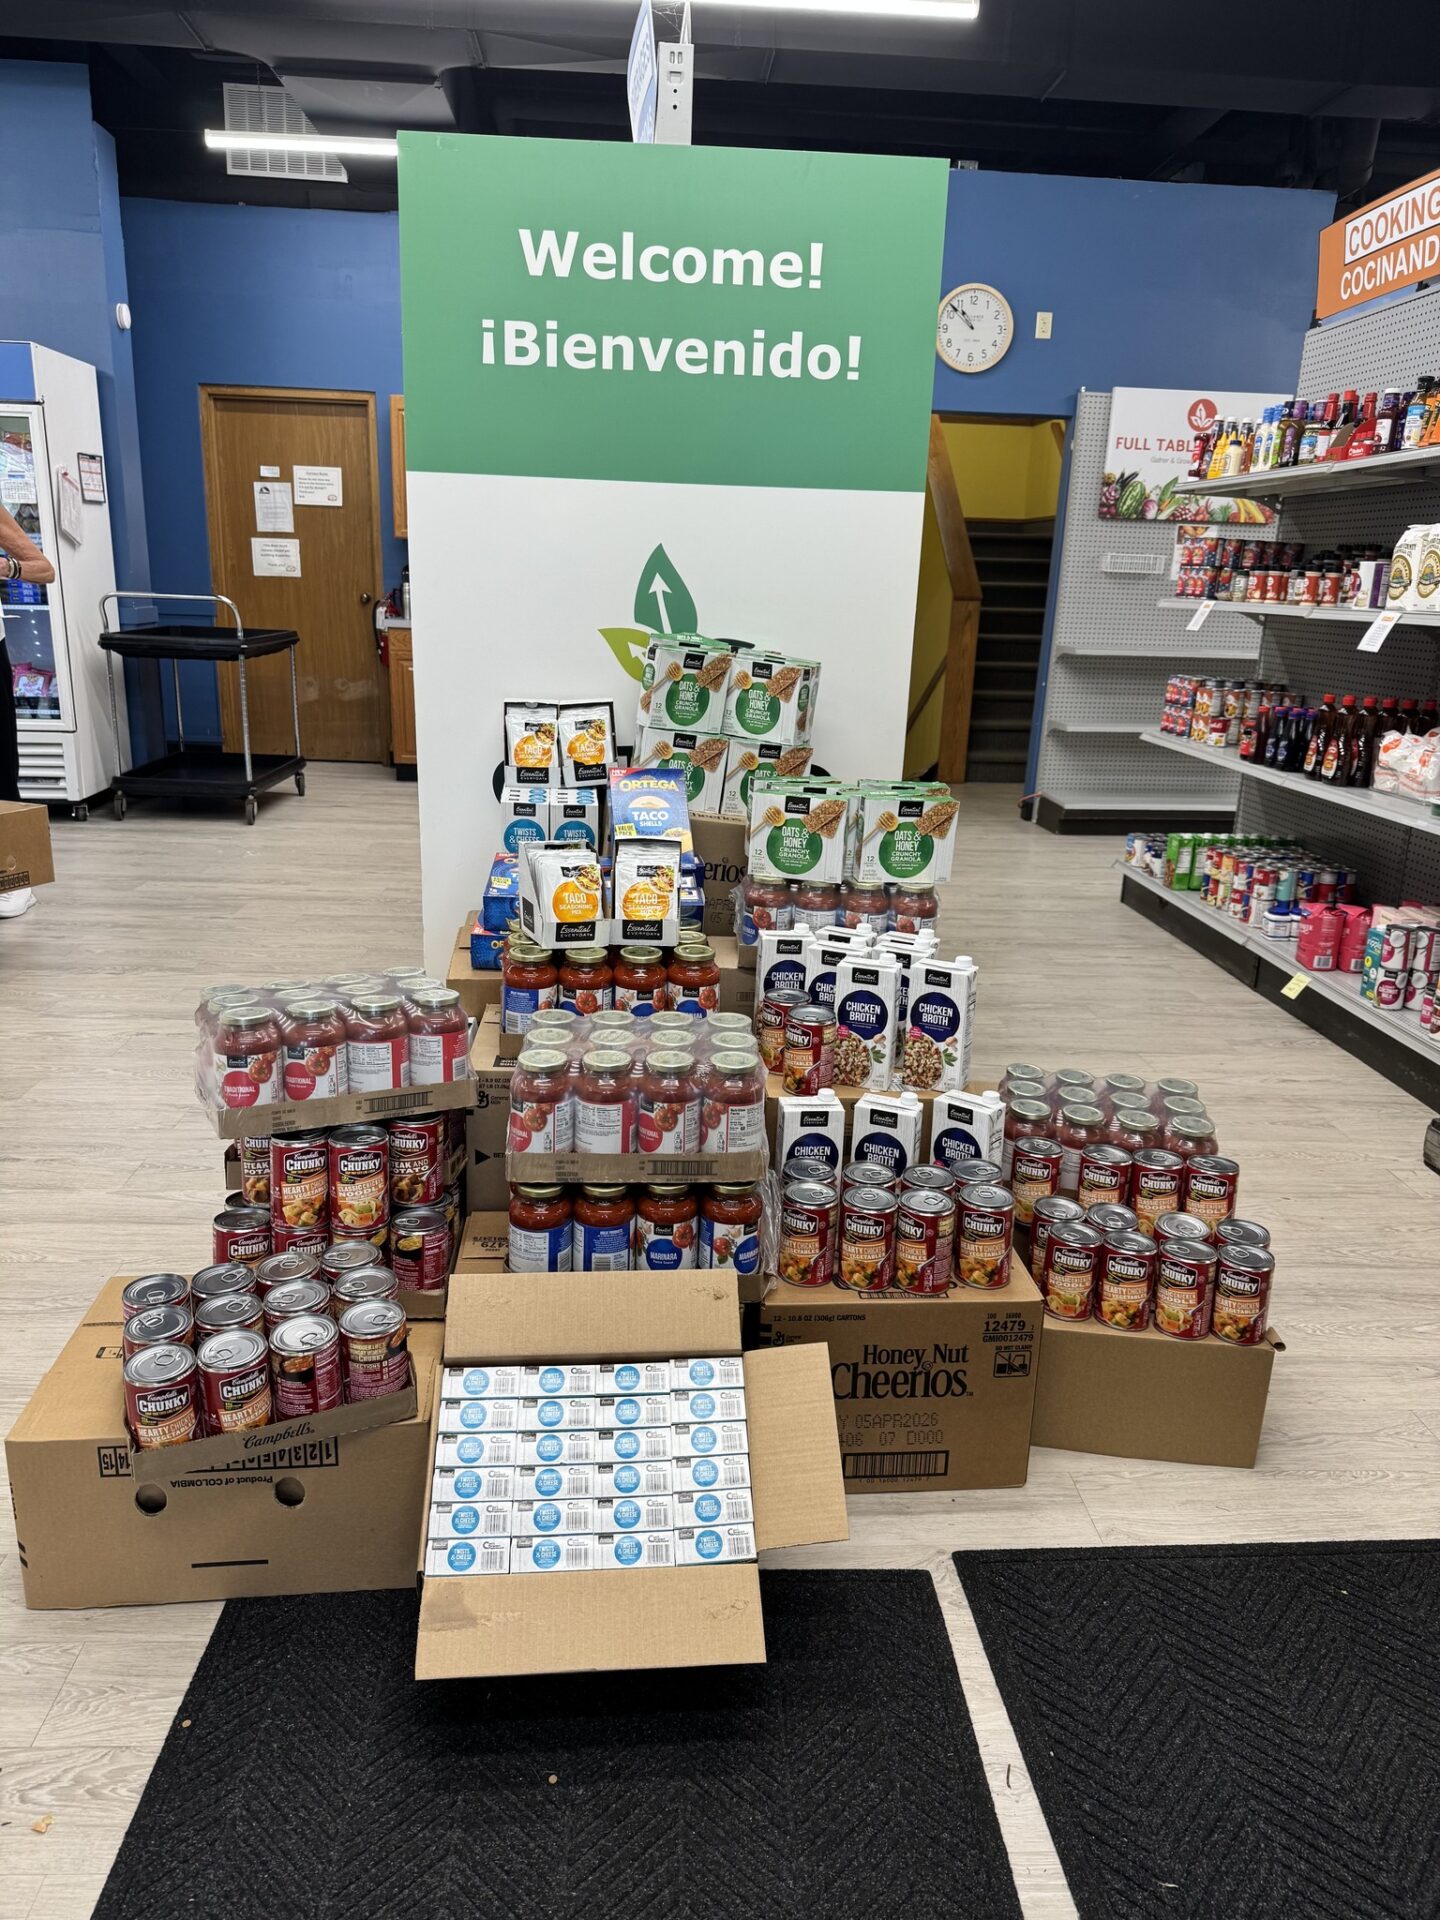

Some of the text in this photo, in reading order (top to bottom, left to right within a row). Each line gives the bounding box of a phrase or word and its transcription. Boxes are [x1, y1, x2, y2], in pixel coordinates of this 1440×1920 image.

[1349, 186, 1440, 257] COOKING
[518, 229, 824, 289] Welcome!
[957, 299, 964, 309] 11
[970, 295, 979, 305] 12
[946, 310, 955, 320] 10
[994, 310, 1001, 320] 2
[942, 324, 948, 334] 9
[997, 325, 1003, 335] 3
[946, 338, 952, 348] 8
[991, 340, 998, 349] 4
[482, 319, 862, 381] ¡Bienvenido!
[955, 348, 961, 358] 7
[981, 349, 987, 359] 5
[967, 352, 974, 362] 6
[1116, 437, 1197, 452] FULL TABL
[679, 681, 693, 691] OATS
[679, 692, 698, 701] HONEY
[748, 689, 763, 699] OATS
[749, 700, 769, 711] HONEY
[577, 743, 595, 752] TACO
[578, 765, 603, 775] Essential
[668, 760, 693, 771] OATS &
[520, 769, 545, 777] Essential
[619, 779, 679, 792] ORTEGA
[632, 811, 669, 821] TACO
[564, 829, 586, 837] TWISTS
[782, 826, 809, 838] OATS &
[894, 830, 921, 841] OATS &
[509, 835, 515, 843] &
[783, 837, 807, 848] HONEY
[895, 841, 919, 851] HONEY
[703, 857, 746, 883] erios
[563, 893, 586, 903] TACO
[635, 893, 658, 904] TACO
[560, 925, 592, 934] Essential
[627, 923, 658, 933] Essential
[771, 971, 804, 981] CHICKEN
[855, 972, 875, 980] Essential
[927, 973, 949, 982] Essential
[775, 980, 800, 989] BROTH
[846, 1001, 881, 1014] CHICKEN
[918, 1003, 954, 1017] CHICKEN
[849, 1011, 876, 1023] BROTH
[922, 1013, 949, 1026] BROTH
[224, 1085, 256, 1093] TRADITIONAL
[950, 1108, 971, 1118] Essential
[872, 1116, 895, 1125] Essential
[244, 1136, 269, 1148] CHUN
[390, 1135, 426, 1149] CHUNKY
[942, 1137, 975, 1154] CHICKEN
[294, 1151, 319, 1160] Campbell's
[794, 1146, 831, 1156] CHICKEN
[863, 1143, 900, 1158] CHICKEN
[348, 1152, 374, 1161] Campbell's
[867, 1153, 895, 1166] BROTH
[244, 1161, 269, 1169] STEAK
[286, 1155, 325, 1171] CHUNKY
[340, 1158, 380, 1172] CHUNKY
[413, 1158, 429, 1167] AND
[1016, 1163, 1049, 1178] CHUNKY
[1084, 1168, 1117, 1185] CHUNKY
[283, 1183, 309, 1195] HEARTY
[338, 1184, 362, 1192] CLASSIC
[1141, 1178, 1177, 1190] CHUNKY
[1191, 1180, 1226, 1196] CHUNKY
[338, 1184, 384, 1197] NOODLE
[851, 1216, 875, 1225] Campbell's
[971, 1214, 994, 1223] Campbell's
[846, 1218, 882, 1236] CHUNKY
[965, 1217, 1002, 1234] CHUNKY
[238, 1236, 264, 1245] Campbell's
[296, 1237, 322, 1246] Campbell's
[230, 1240, 269, 1256] CHUNKY
[289, 1241, 327, 1255] CHUNKY
[1061, 1249, 1086, 1258] Campbell's
[650, 1251, 677, 1260] MARINARA
[1055, 1251, 1092, 1268] CHUNKY
[1115, 1257, 1139, 1266] Campbell's
[1165, 1261, 1187, 1273] Campbell's
[1108, 1260, 1146, 1277] CHUNKY
[1161, 1264, 1195, 1285] CHUNKY
[1226, 1270, 1250, 1281] Campbell's
[1221, 1273, 1258, 1292] CHUNKY
[1104, 1286, 1127, 1296] HEARTY
[983, 1320, 1026, 1332] 12479
[863, 1344, 969, 1370] Honey Nut
[231, 1371, 260, 1386] Campbell's
[831, 1361, 968, 1400] Cheerios
[222, 1372, 266, 1398] CHUNKY
[147, 1389, 178, 1401] Campbell's
[139, 1391, 187, 1413] CHUNKY
[221, 1406, 252, 1422] HEARTY
[140, 1412, 195, 1437] HEARTY CHICKEN
[855, 1412, 939, 1429] 05APR2026
[243, 1422, 312, 1449] Campbell's
[309, 1443, 318, 1460] 2
[102, 1453, 115, 1470] 15
[170, 1476, 273, 1488] Product of COLOMBIA
